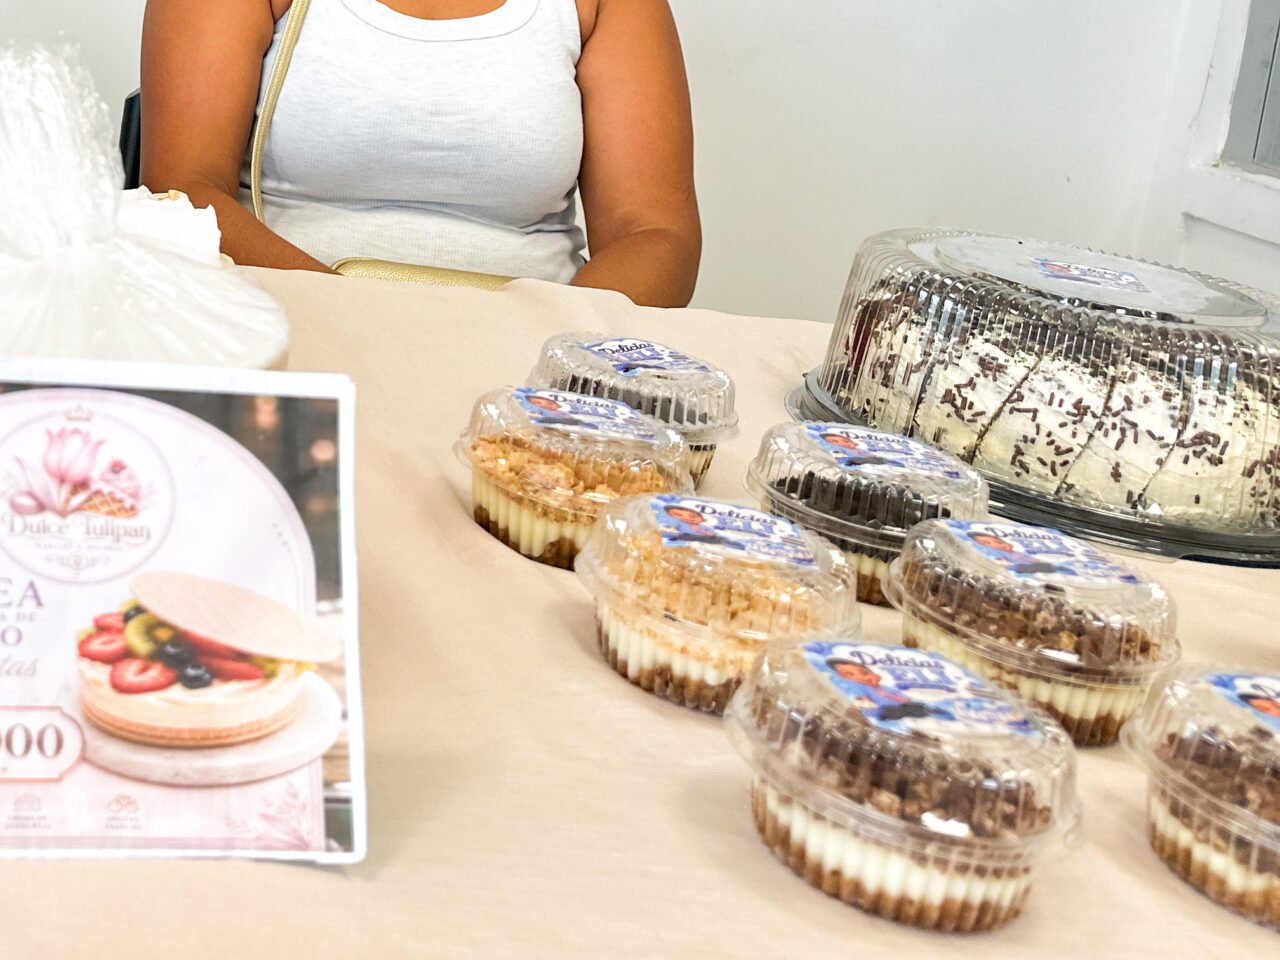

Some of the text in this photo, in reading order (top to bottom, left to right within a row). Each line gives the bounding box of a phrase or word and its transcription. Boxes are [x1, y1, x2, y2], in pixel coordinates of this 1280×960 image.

[695, 505, 777, 525] Delicias
[1, 514, 152, 542] Dulce Tulipan
[15, 611, 38, 623] DE
[849, 650, 944, 670] Delicias
